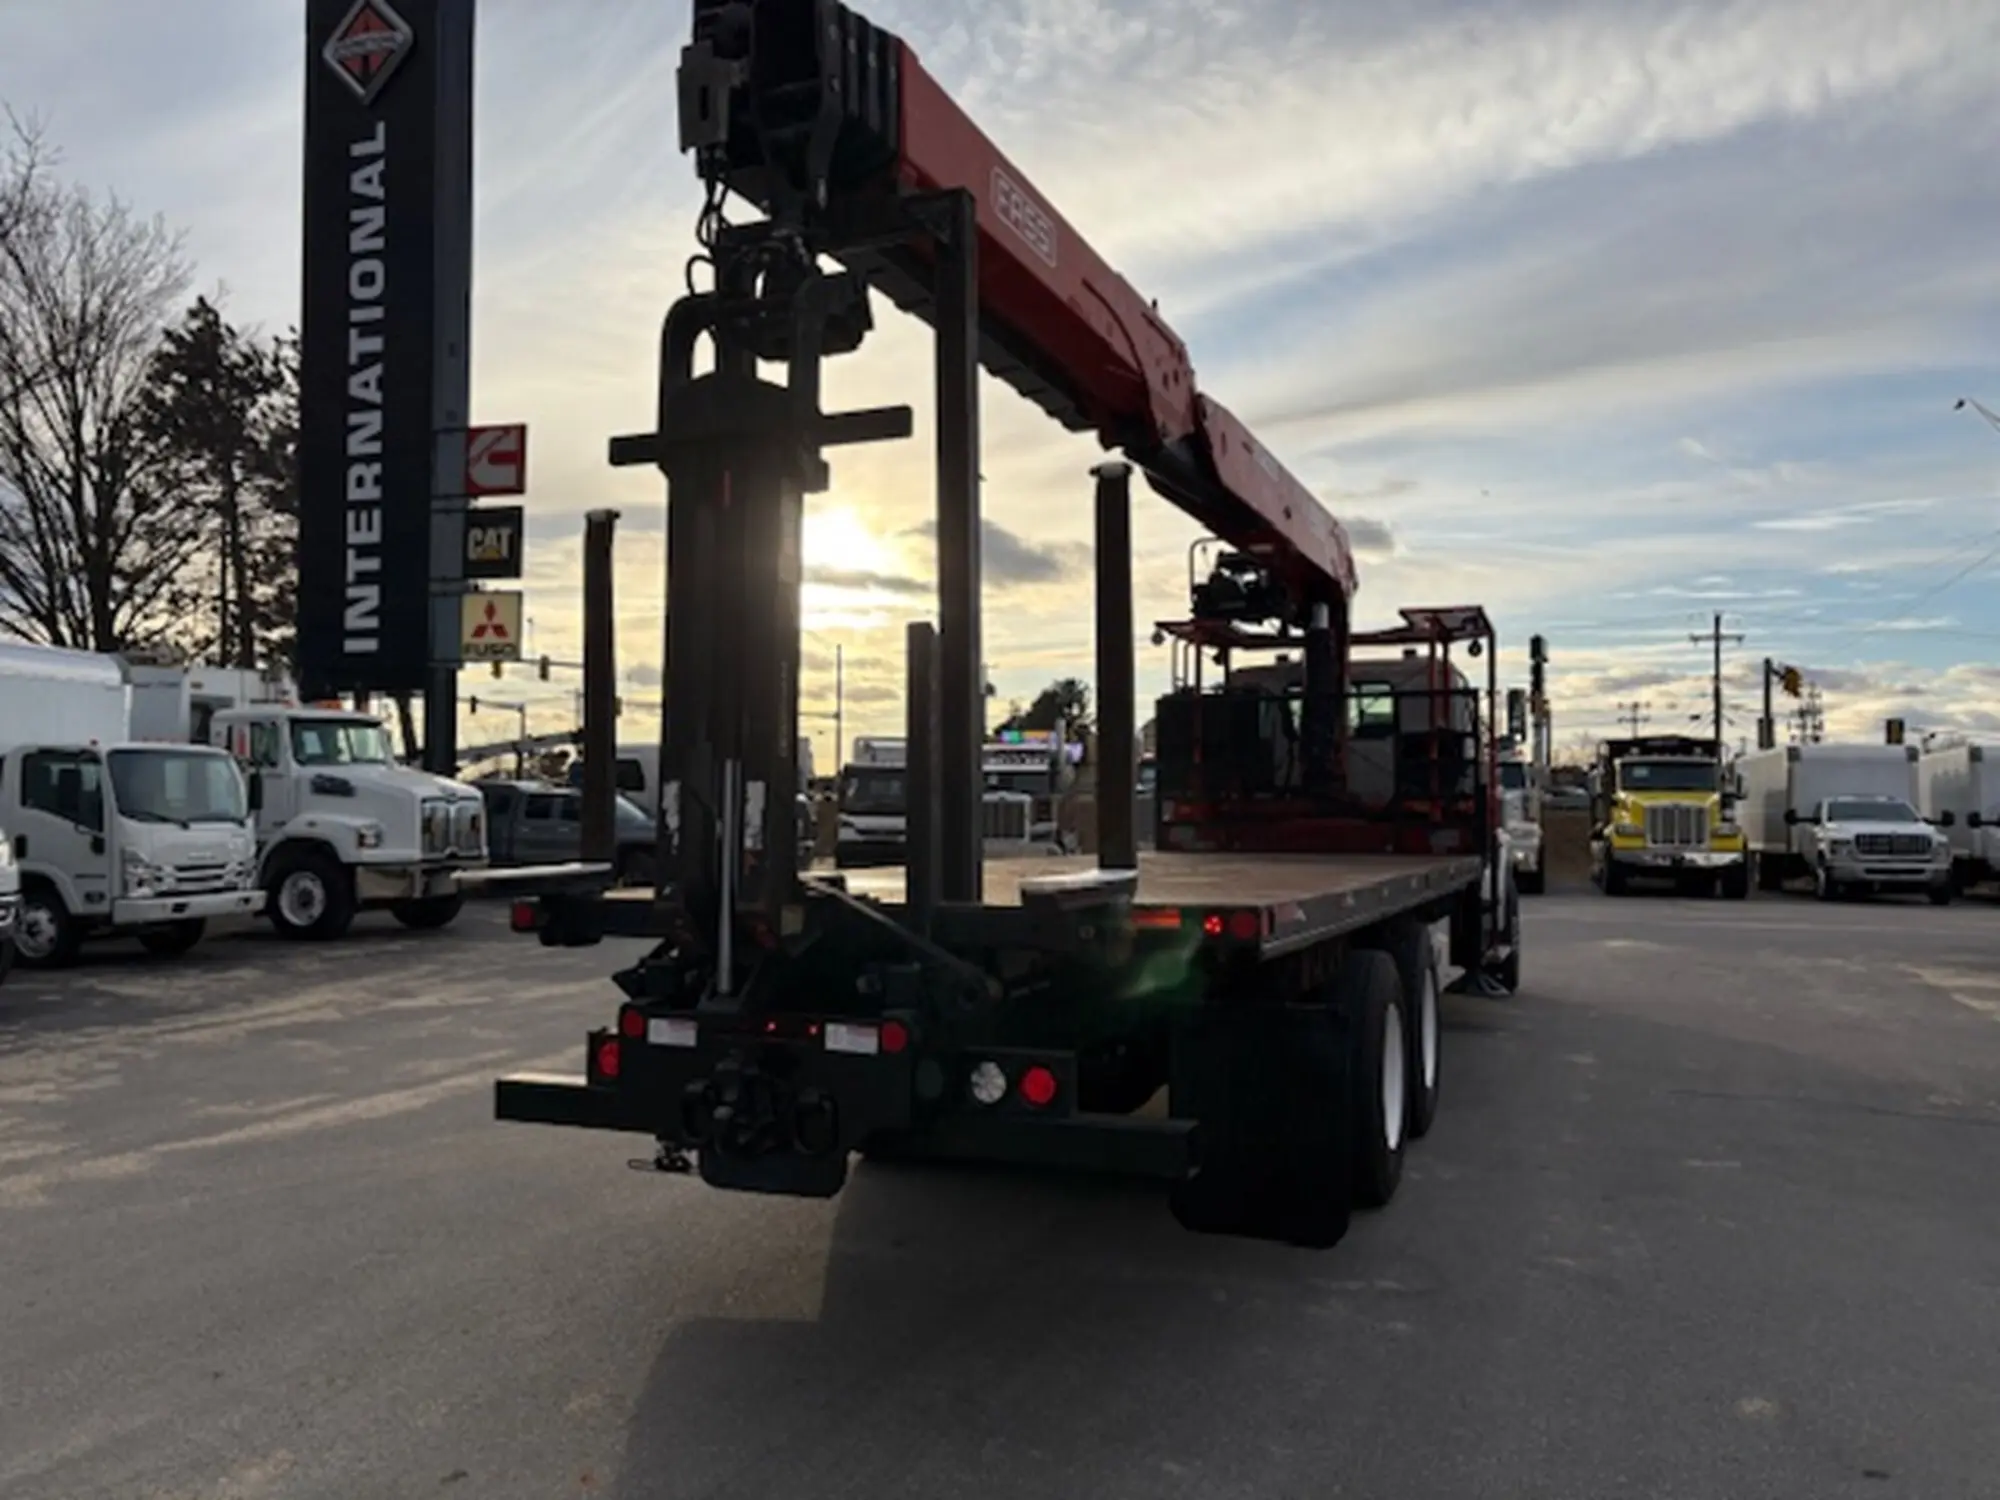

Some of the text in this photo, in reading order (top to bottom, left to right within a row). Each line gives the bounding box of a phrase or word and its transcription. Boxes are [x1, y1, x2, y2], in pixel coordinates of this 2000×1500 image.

[343, 121, 386, 654] INTERNATIONAL
[468, 527, 512, 560] CAT
[464, 643, 517, 657] FUSO
